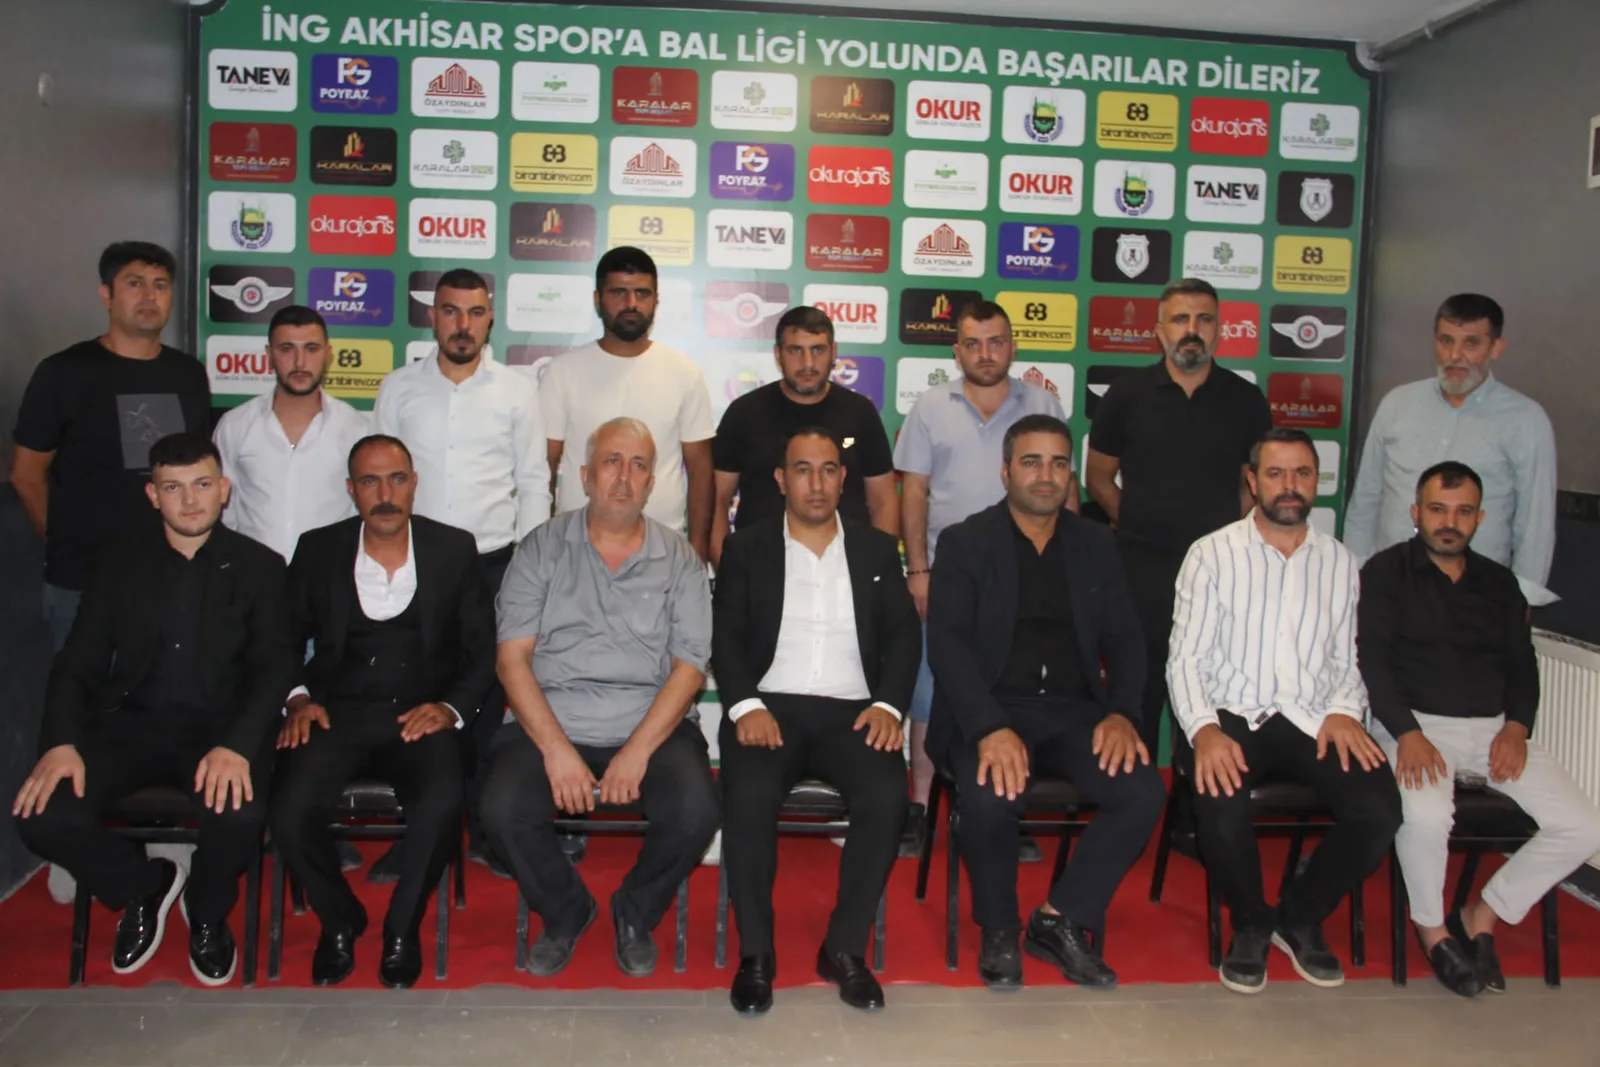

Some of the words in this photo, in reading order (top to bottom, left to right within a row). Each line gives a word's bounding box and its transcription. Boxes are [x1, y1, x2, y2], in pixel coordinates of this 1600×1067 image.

[263, 5, 331, 43] İNG
[340, 12, 503, 50] AKHİSAR
[514, 24, 648, 57] SPOR'A
[659, 31, 727, 61] BAL
[737, 28, 806, 64] LİGİ
[817, 38, 987, 74] YOLUNDA
[998, 48, 1188, 86] BAŞARILAR
[1198, 55, 1320, 95] DİLERİZ
[319, 88, 371, 100] POYRAZ
[616, 99, 692, 111] KARALAR
[915, 98, 982, 122] OKUR
[816, 112, 890, 122] KARALAR
[1190, 117, 1268, 139] okurajans
[213, 155, 291, 167] KARALAR
[316, 162, 393, 172] KARALAR
[718, 175, 768, 187] POYRAZ
[808, 164, 891, 187] okurajans
[1008, 172, 1074, 195] OKUR
[310, 214, 395, 237] okurajans
[418, 215, 487, 239] OKUR
[515, 236, 593, 248] KARALAR
[809, 245, 884, 257] KARALAR
[1005, 255, 1053, 267] POYRAZ
[316, 300, 366, 312] POYRAZ
[216, 352, 273, 375] OKU
[1270, 402, 1337, 413] KARALAR
